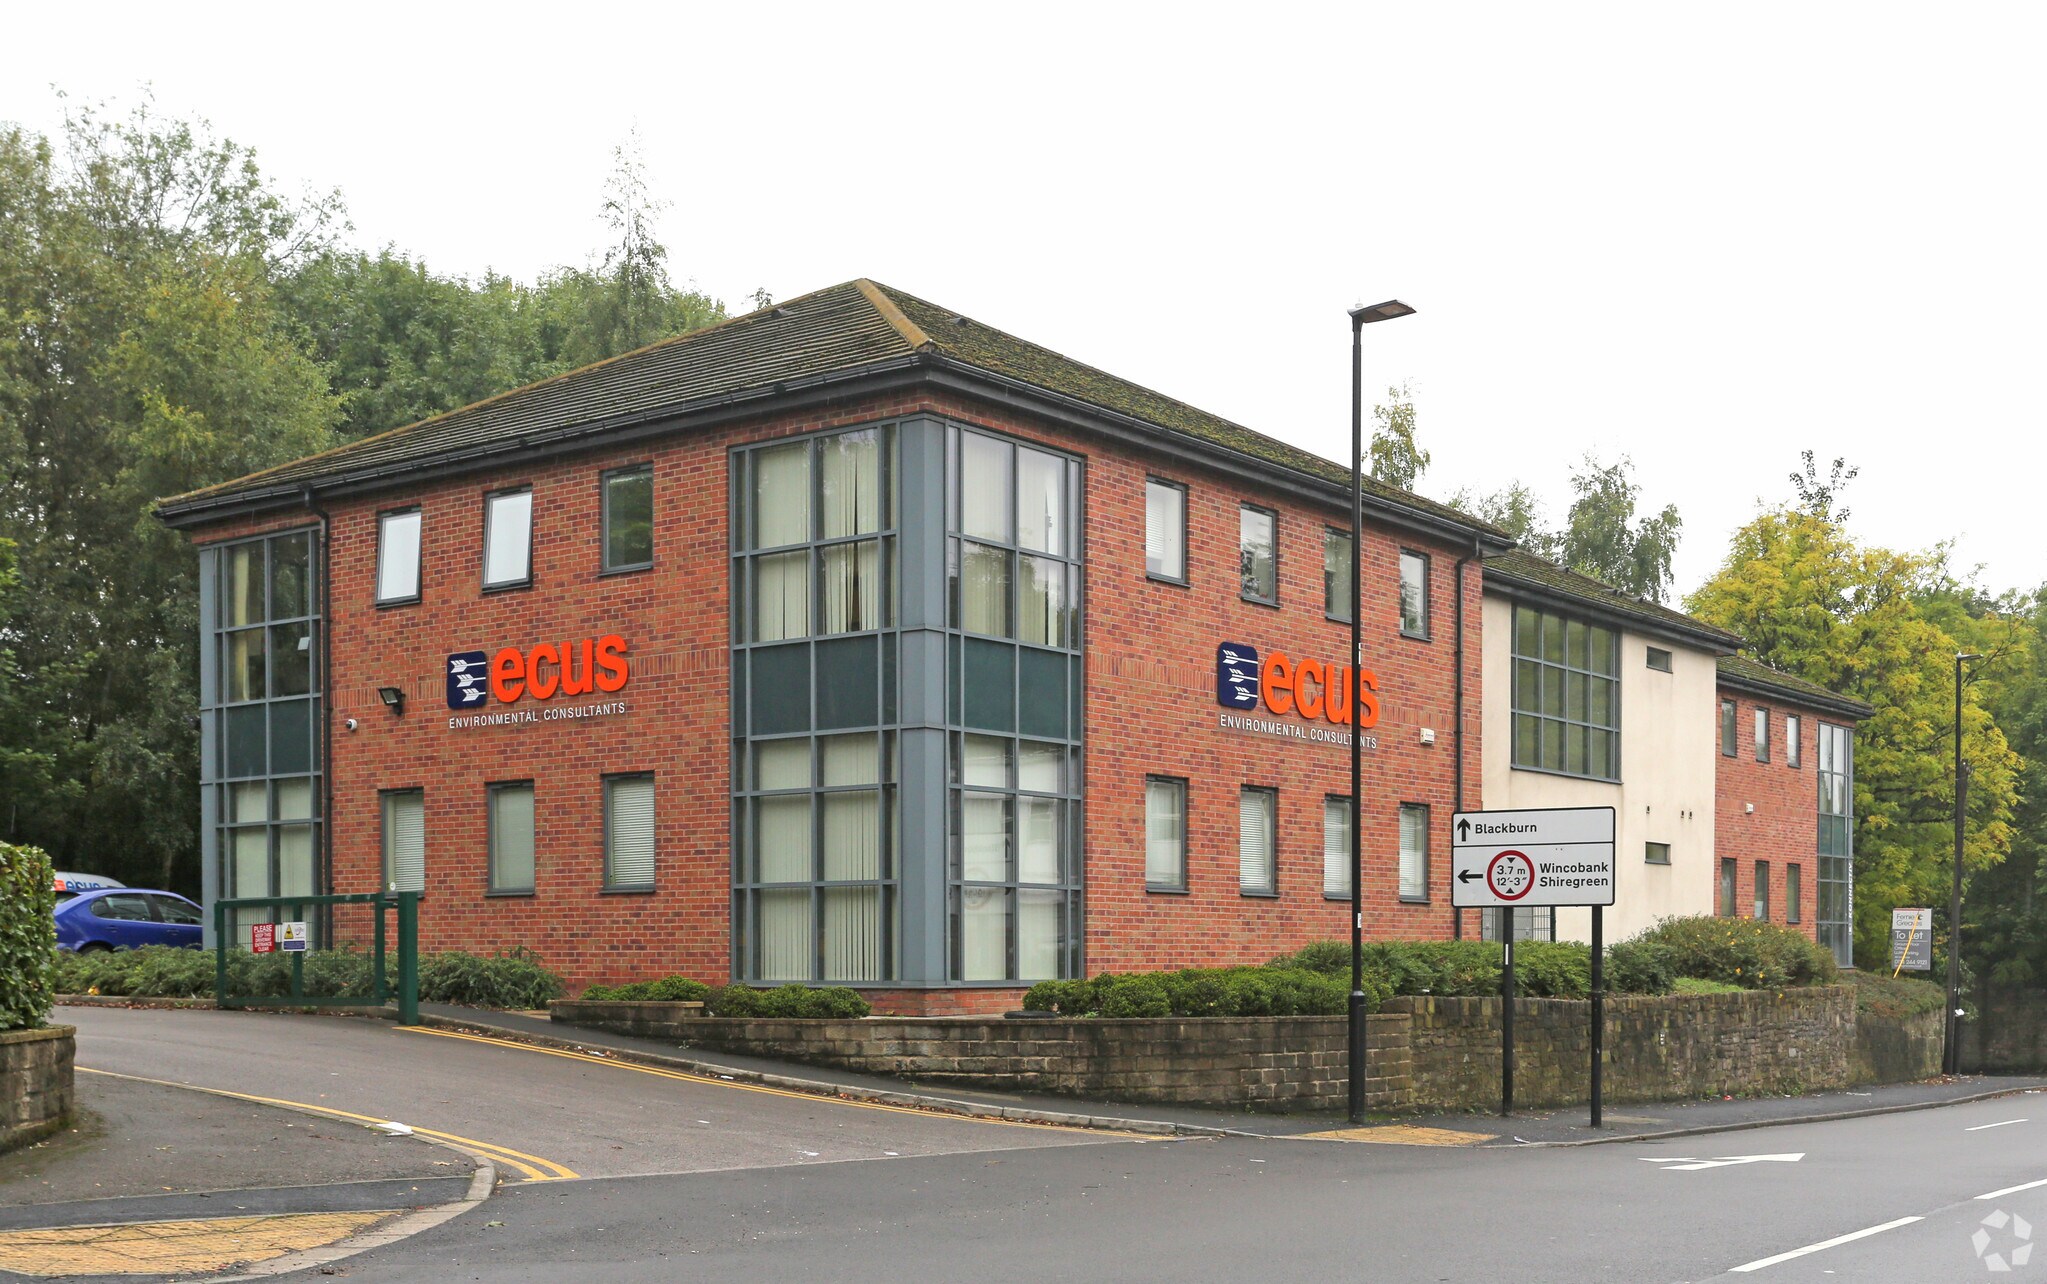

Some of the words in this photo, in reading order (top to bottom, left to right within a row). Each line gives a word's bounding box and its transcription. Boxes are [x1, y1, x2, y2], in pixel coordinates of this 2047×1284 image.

[491, 634, 629, 703] ecus
[1262, 652, 1379, 729] ecus
[449, 711, 539, 729] ENVIRONMENTAL
[543, 702, 625, 721] CONSULTANTS
[1220, 714, 1307, 739] ENVIRONMENTAL
[1310, 728, 1377, 749] CONSULTNTS
[1475, 823, 1537, 834] Blackburn
[1496, 865, 1514, 875] 3.7
[1539, 862, 1609, 874] Wincobank
[1539, 876, 1609, 889] Shiregreen
[254, 924, 272, 933] PLEASE
[1895, 931, 1906, 940] To
